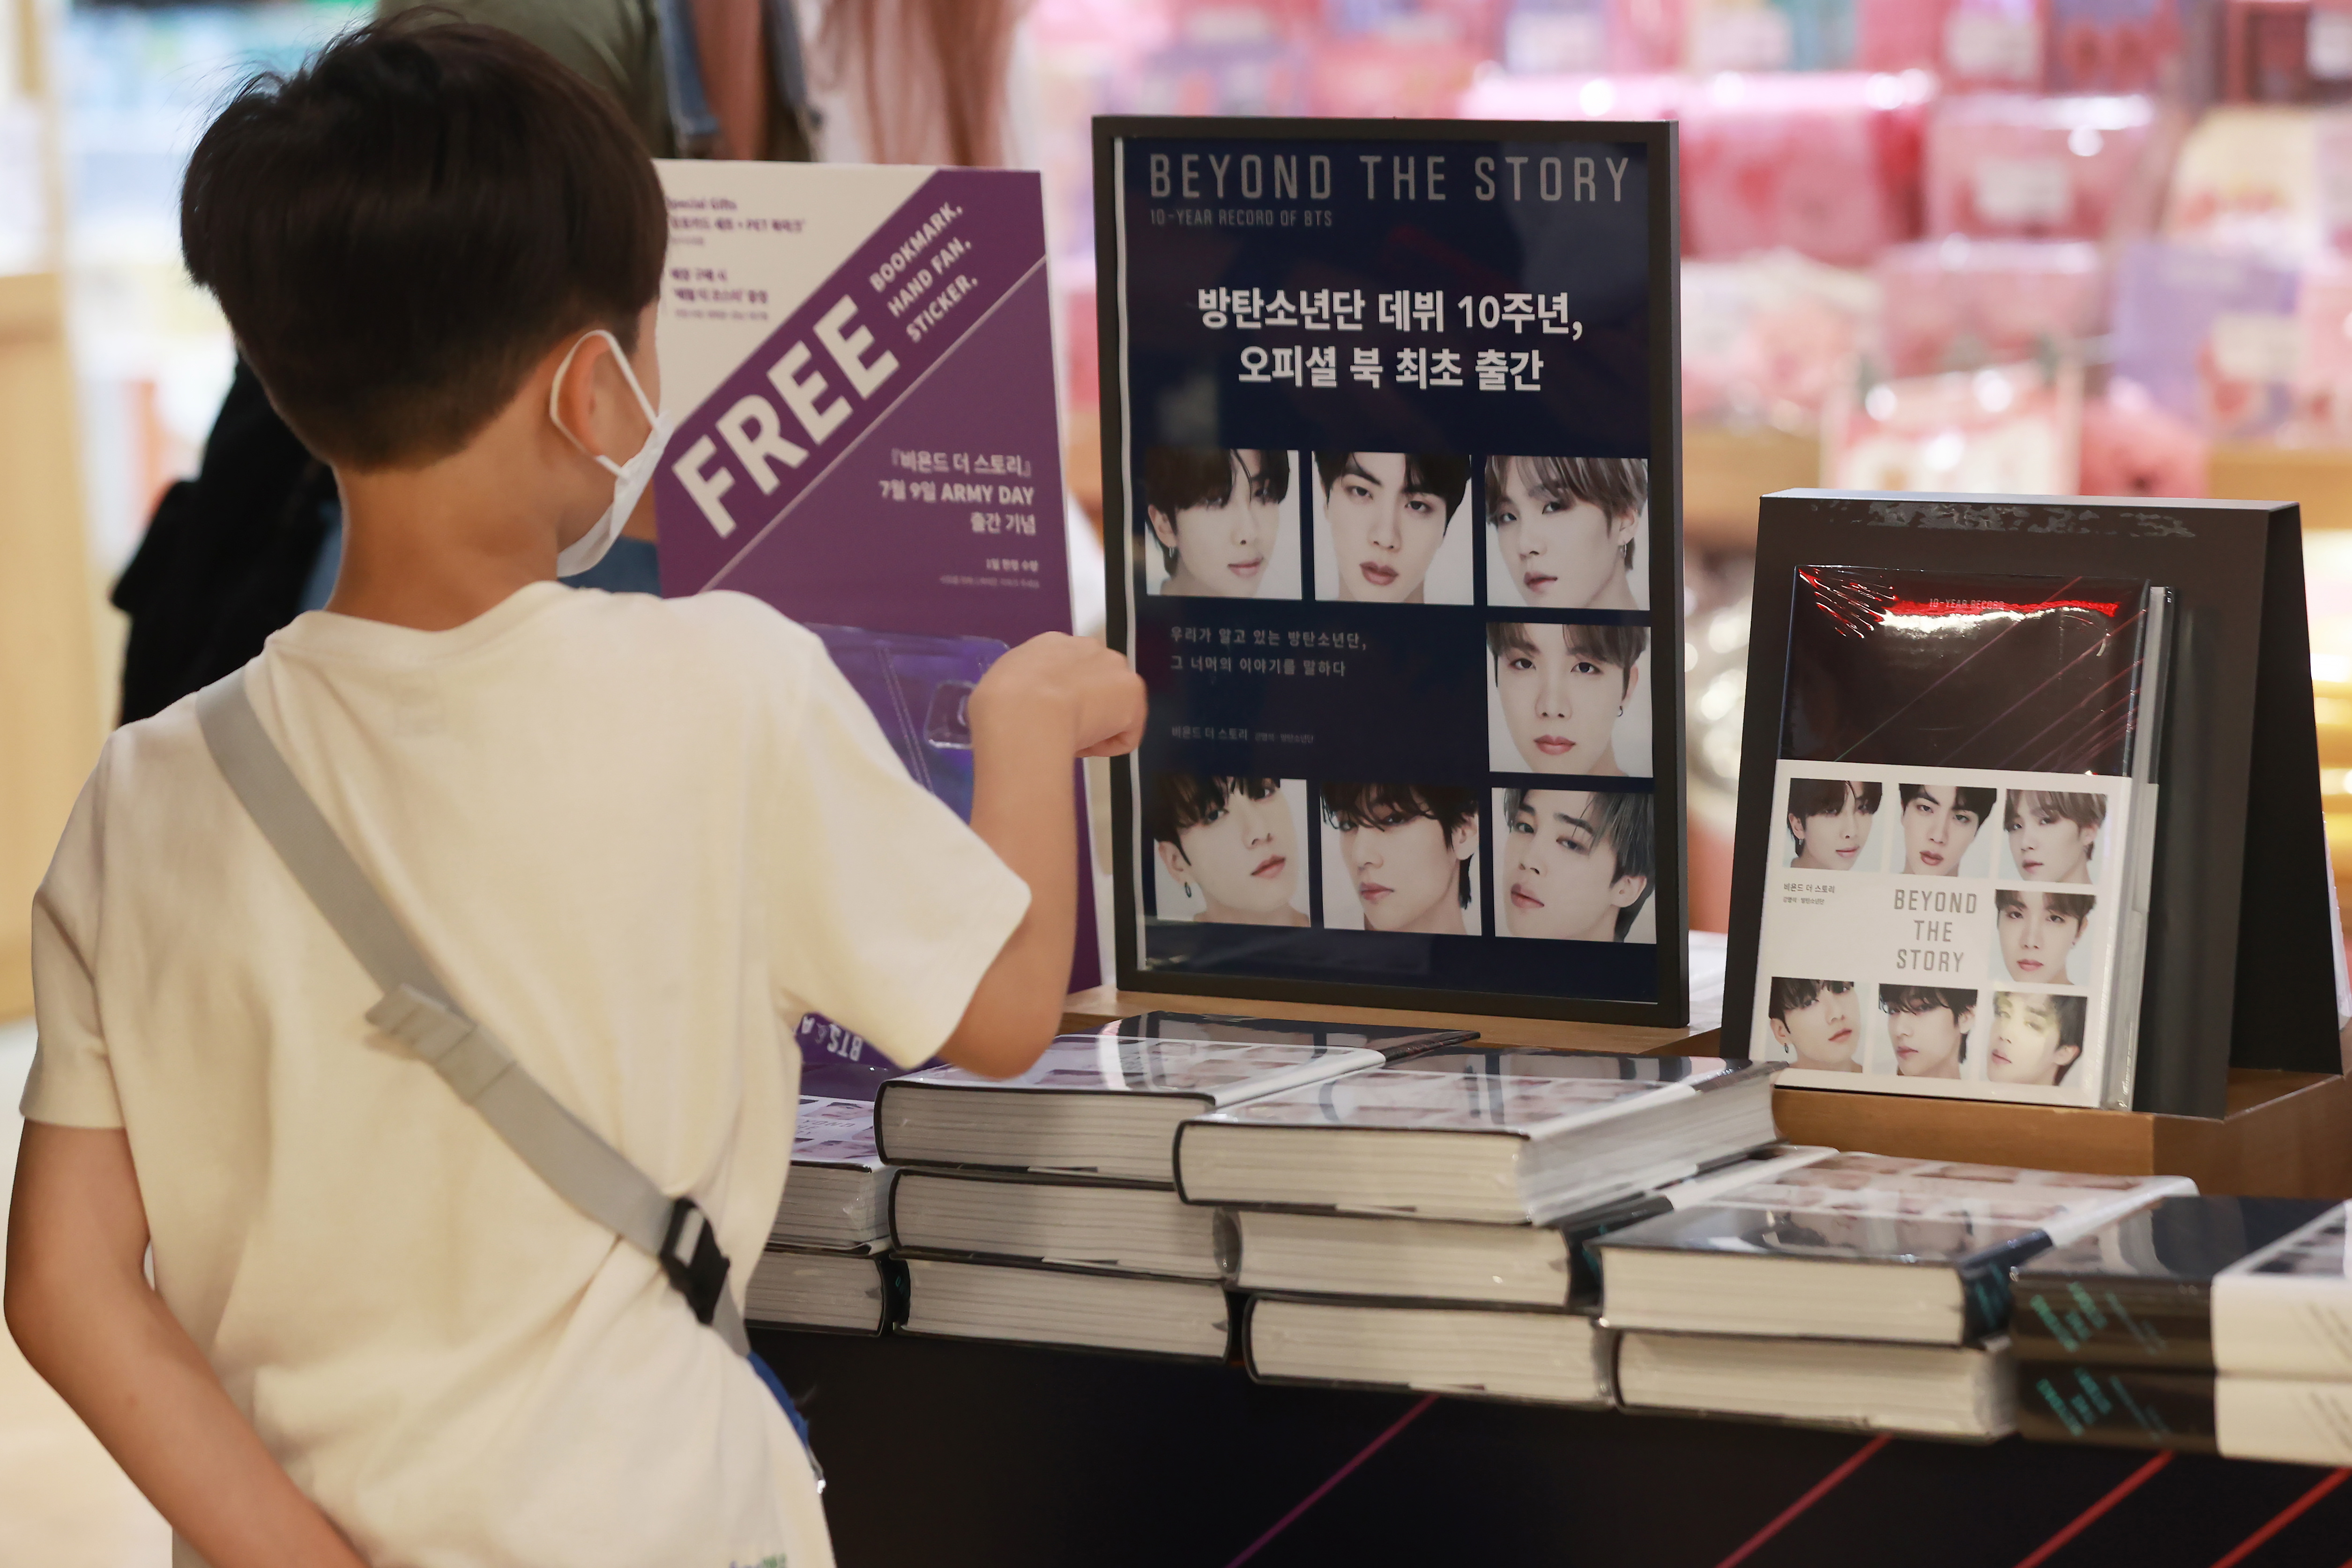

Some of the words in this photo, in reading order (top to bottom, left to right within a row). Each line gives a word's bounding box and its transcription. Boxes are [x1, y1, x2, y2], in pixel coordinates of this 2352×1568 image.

[1150, 154, 1331, 199] BEYOND
[1359, 155, 1446, 201] THE
[1474, 156, 1629, 202] STORY
[1151, 209, 1212, 226] 10-YEAR
[1219, 209, 1273, 227] RECORD
[1280, 209, 1296, 227] OF
[1304, 210, 1332, 227] BTS
[869, 201, 963, 293] BOOKMARK.
[887, 269, 933, 318] HAND
[930, 237, 971, 275] FAN.
[906, 275, 978, 342] STICKER.
[1198, 287, 1366, 331] 방탄소년단
[1378, 290, 1444, 333] 데뷔
[1458, 292, 1583, 341] 10주년,
[1238, 345, 1338, 388] 오피셜
[1350, 347, 1384, 389] 북
[1395, 347, 1464, 390] 최초
[1475, 349, 1544, 391] 출간
[671, 294, 900, 539] FREE
[953, 452, 970, 475] 더
[878, 479, 907, 502] 7월
[910, 480, 936, 503] 9일
[941, 483, 994, 505] ARMY
[998, 485, 1034, 505] DAY
[971, 512, 1001, 534] 출간
[1006, 513, 1036, 536] 기념
[1929, 598, 1967, 608] 10-YEAR
[1171, 626, 1212, 643] 우리가
[1219, 628, 1246, 645] 알고
[1253, 629, 1280, 646] 있는
[1288, 631, 1367, 651] 방탄소년단,
[1171, 656, 1183, 669] 그
[1191, 656, 1231, 672] 너머의
[1240, 658, 1295, 675] 이야기를
[1303, 660, 1345, 677] 말하다
[1205, 727, 1214, 740] 더
[1219, 728, 1247, 741] 스토리
[1806, 884, 1813, 893] 더
[1815, 885, 1835, 893] 스토리
[1894, 889, 1977, 914] BEYOND
[1913, 919, 1953, 942] THE
[1897, 949, 1964, 972] STORY
[826, 1023, 863, 1062] BTS
